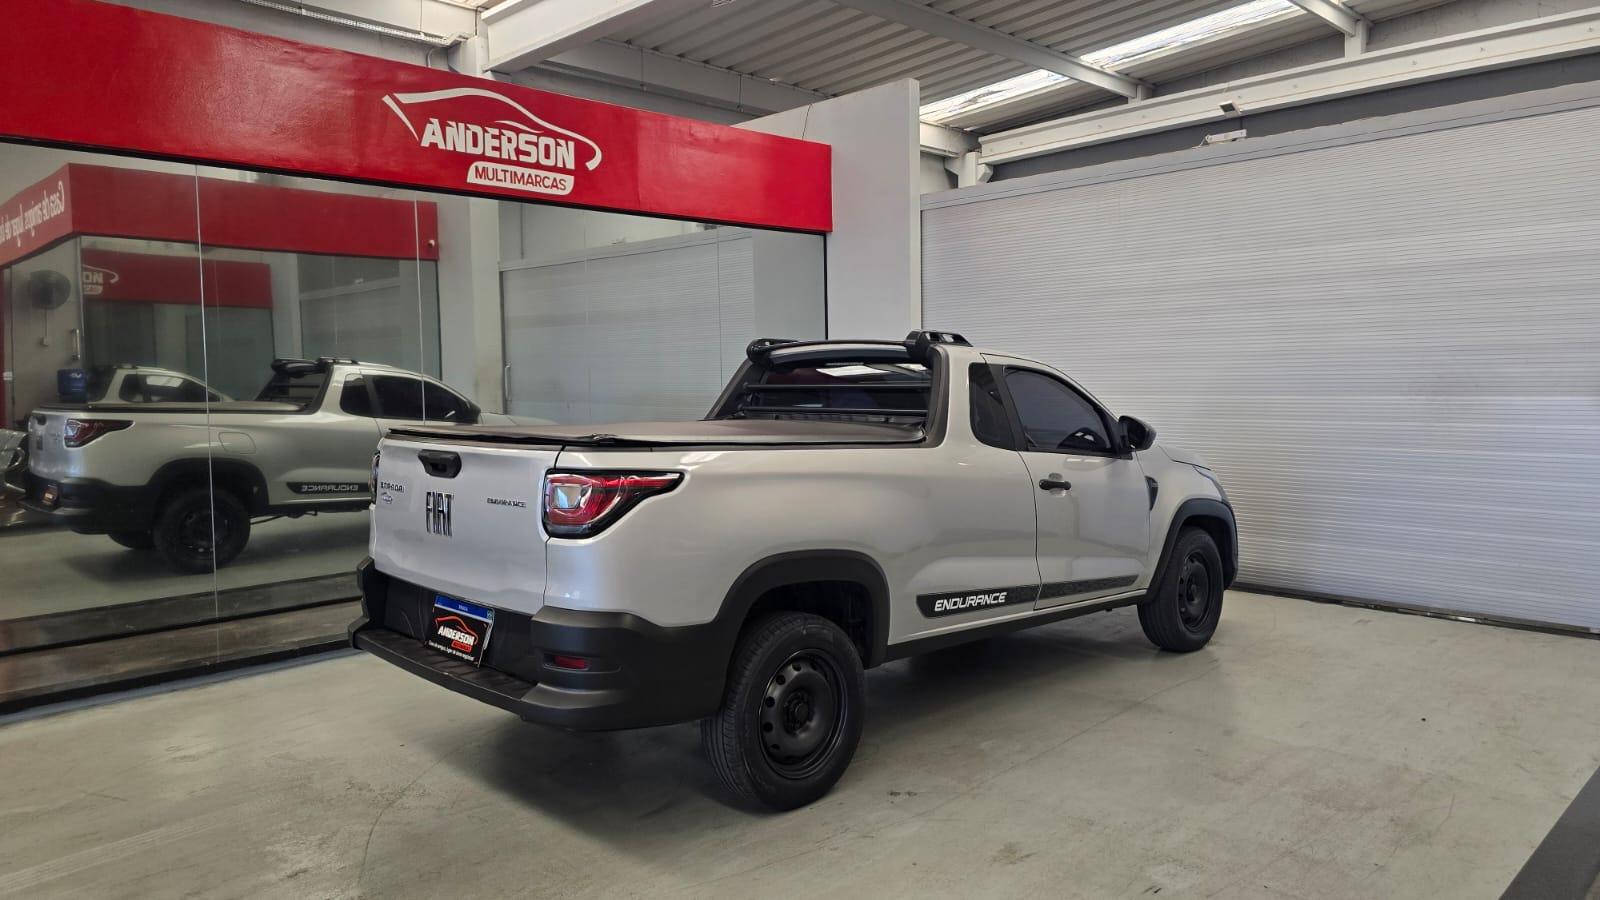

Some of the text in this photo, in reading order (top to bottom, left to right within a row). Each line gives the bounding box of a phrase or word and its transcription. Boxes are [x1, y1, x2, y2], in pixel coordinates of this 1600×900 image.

[420, 117, 576, 170] ANDERSON
[474, 165, 567, 191] MULTIMARCAS
[425, 491, 454, 537] FIAT
[934, 591, 1008, 612] ENDURANCE
[437, 625, 476, 646] ANDERSON
